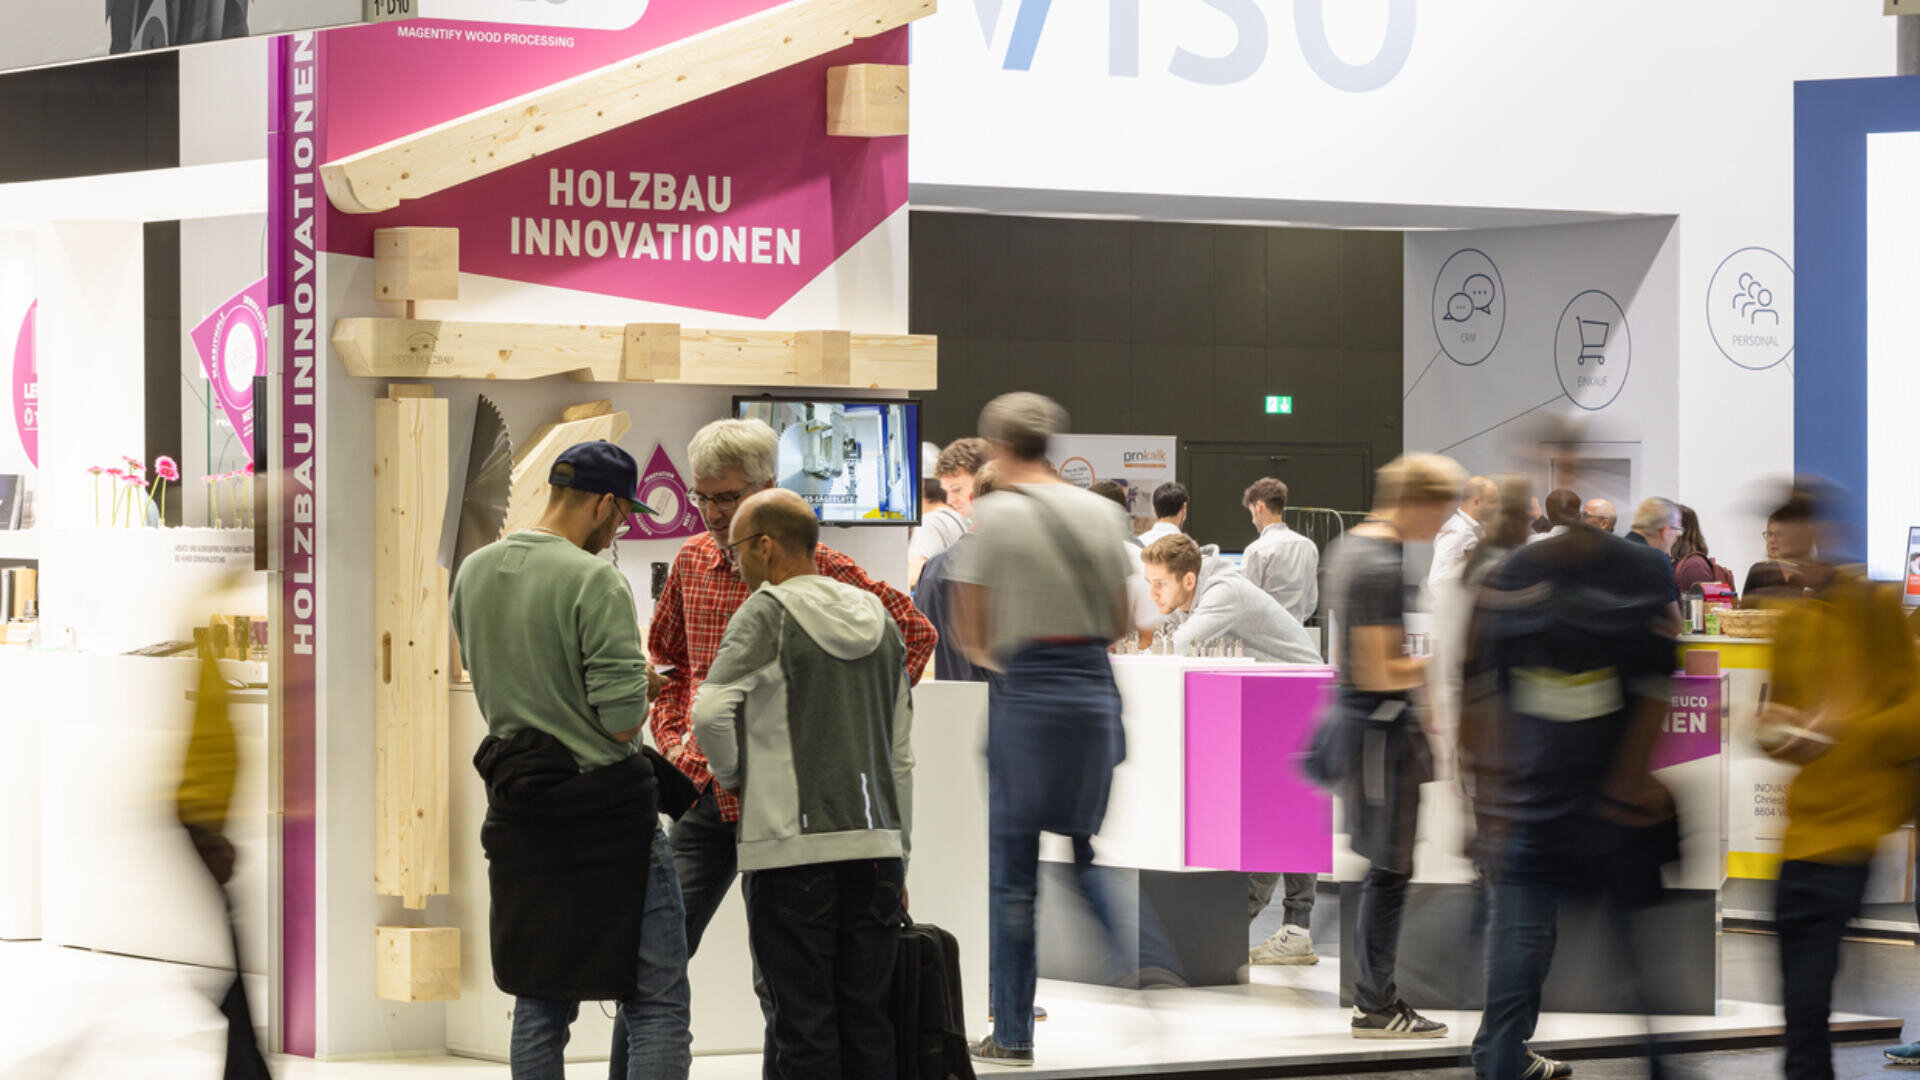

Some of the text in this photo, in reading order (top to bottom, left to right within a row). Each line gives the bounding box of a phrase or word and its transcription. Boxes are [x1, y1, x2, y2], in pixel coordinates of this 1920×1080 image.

[397, 26, 575, 48] MAGENTIFY WOOD PROCESSING
[549, 168, 732, 213] HOLZBAU
[510, 216, 800, 266] INNOVATIONEN
[294, 30, 314, 655] HOLZBAU INNOVATIONEN
[1460, 332, 1477, 344] CRM
[1731, 334, 1780, 347] PERSONAL
[1576, 375, 1608, 389] EINKAUF
[1753, 807, 1776, 817] 8604
